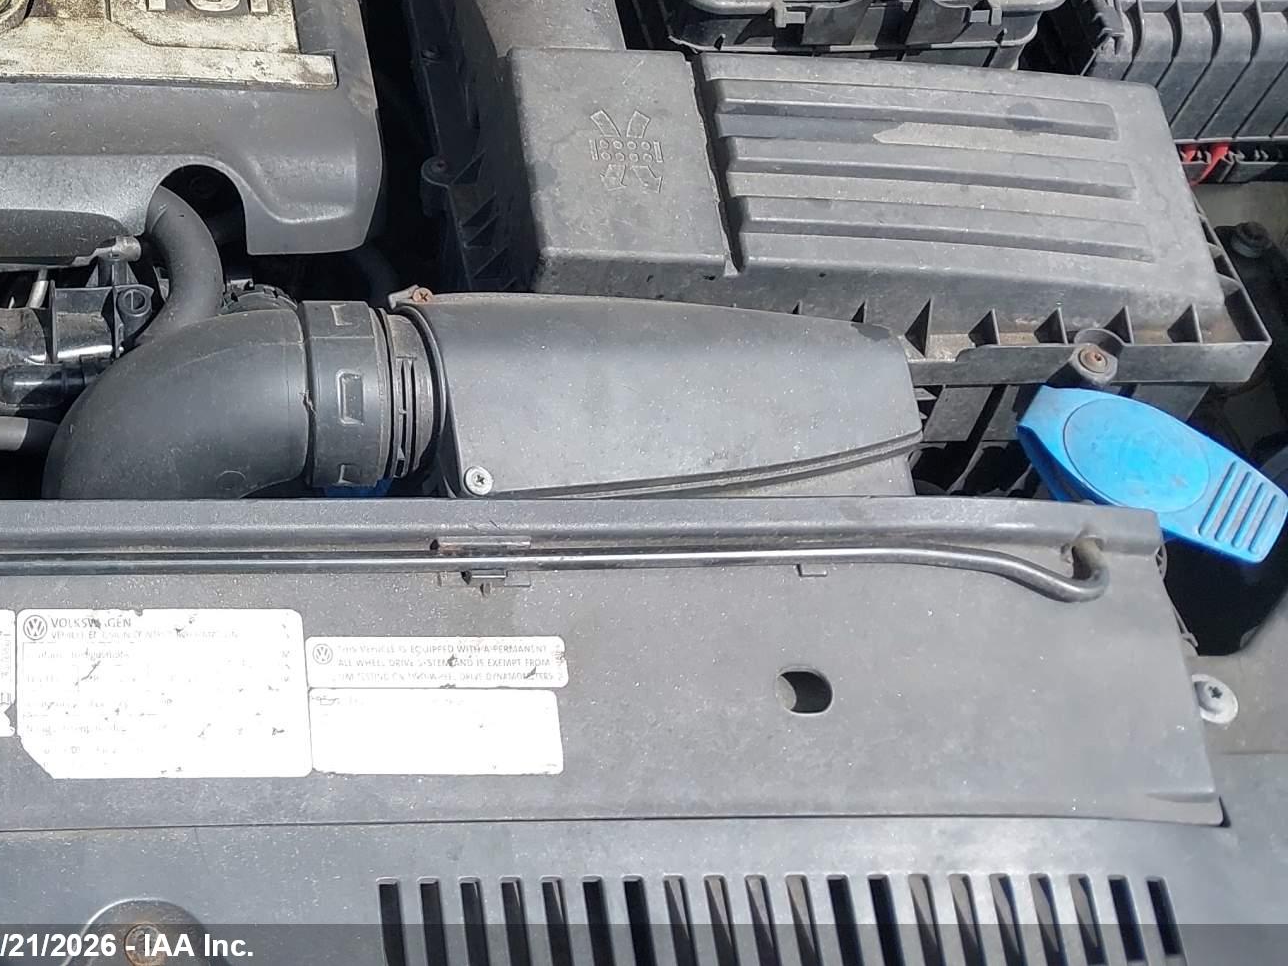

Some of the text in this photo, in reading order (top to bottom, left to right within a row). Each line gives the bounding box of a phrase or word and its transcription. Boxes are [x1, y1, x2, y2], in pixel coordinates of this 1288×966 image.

[50, 618, 132, 629] VOLKSWGEN
[456, 644, 481, 653] WITH
[487, 658, 521, 667] EXEMPT
[524, 658, 550, 667] FROM
